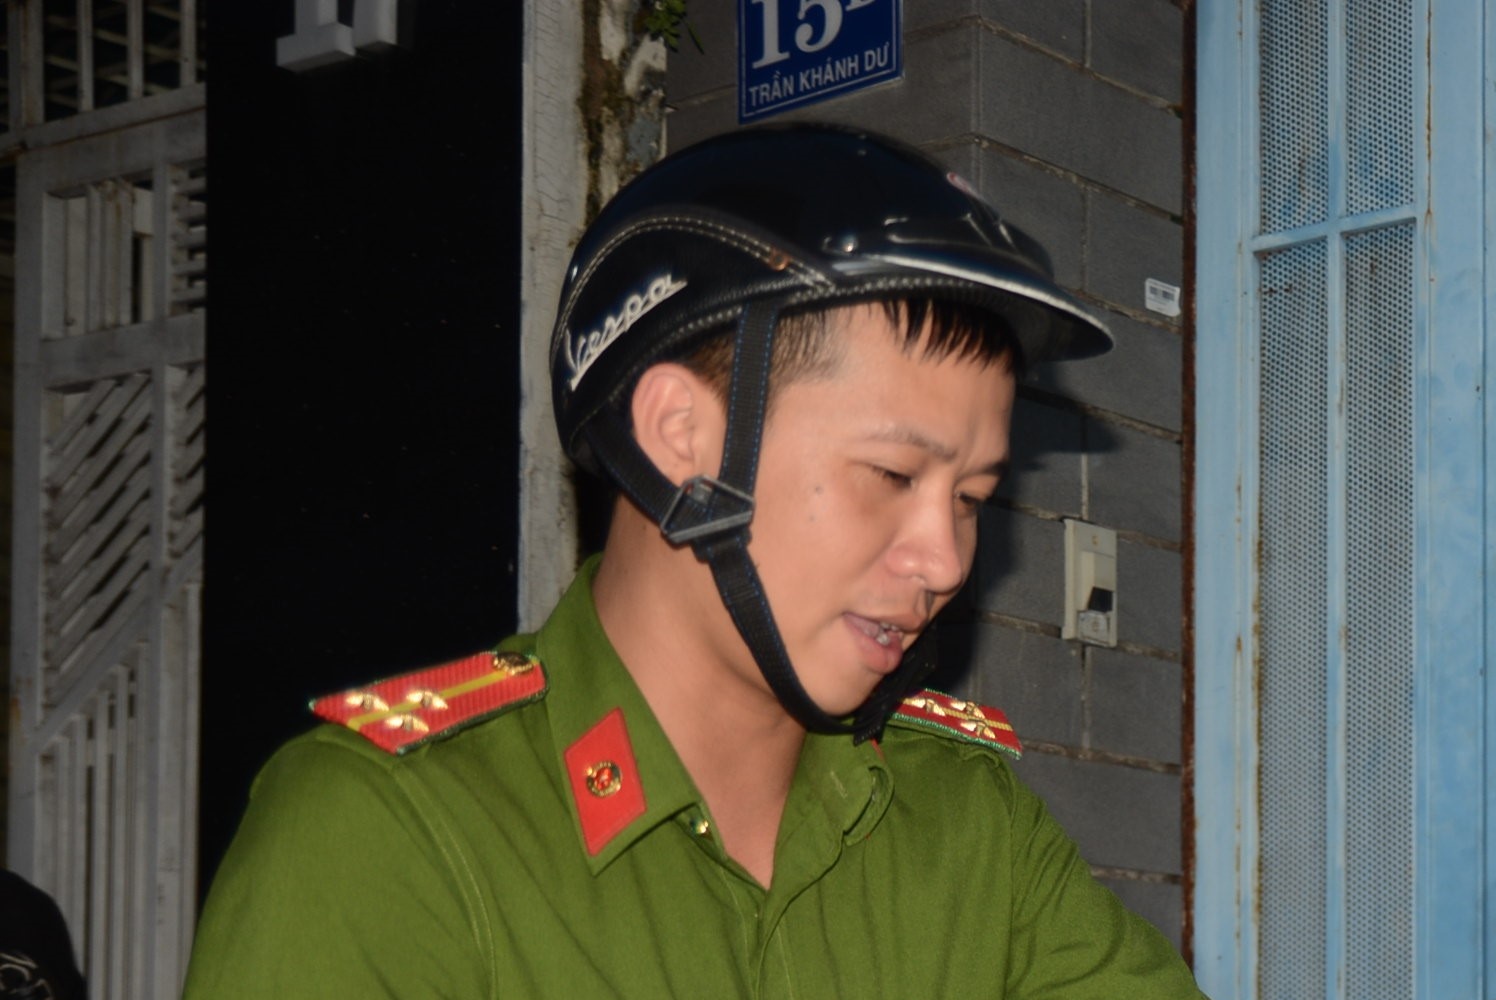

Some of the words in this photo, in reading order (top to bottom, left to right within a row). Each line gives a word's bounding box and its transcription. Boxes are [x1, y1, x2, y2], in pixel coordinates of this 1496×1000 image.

[749, 70, 794, 107] TRẦN
[800, 57, 859, 92] KHÁNH
[864, 41, 890, 71] DƯ
[566, 272, 688, 391] Vespa
